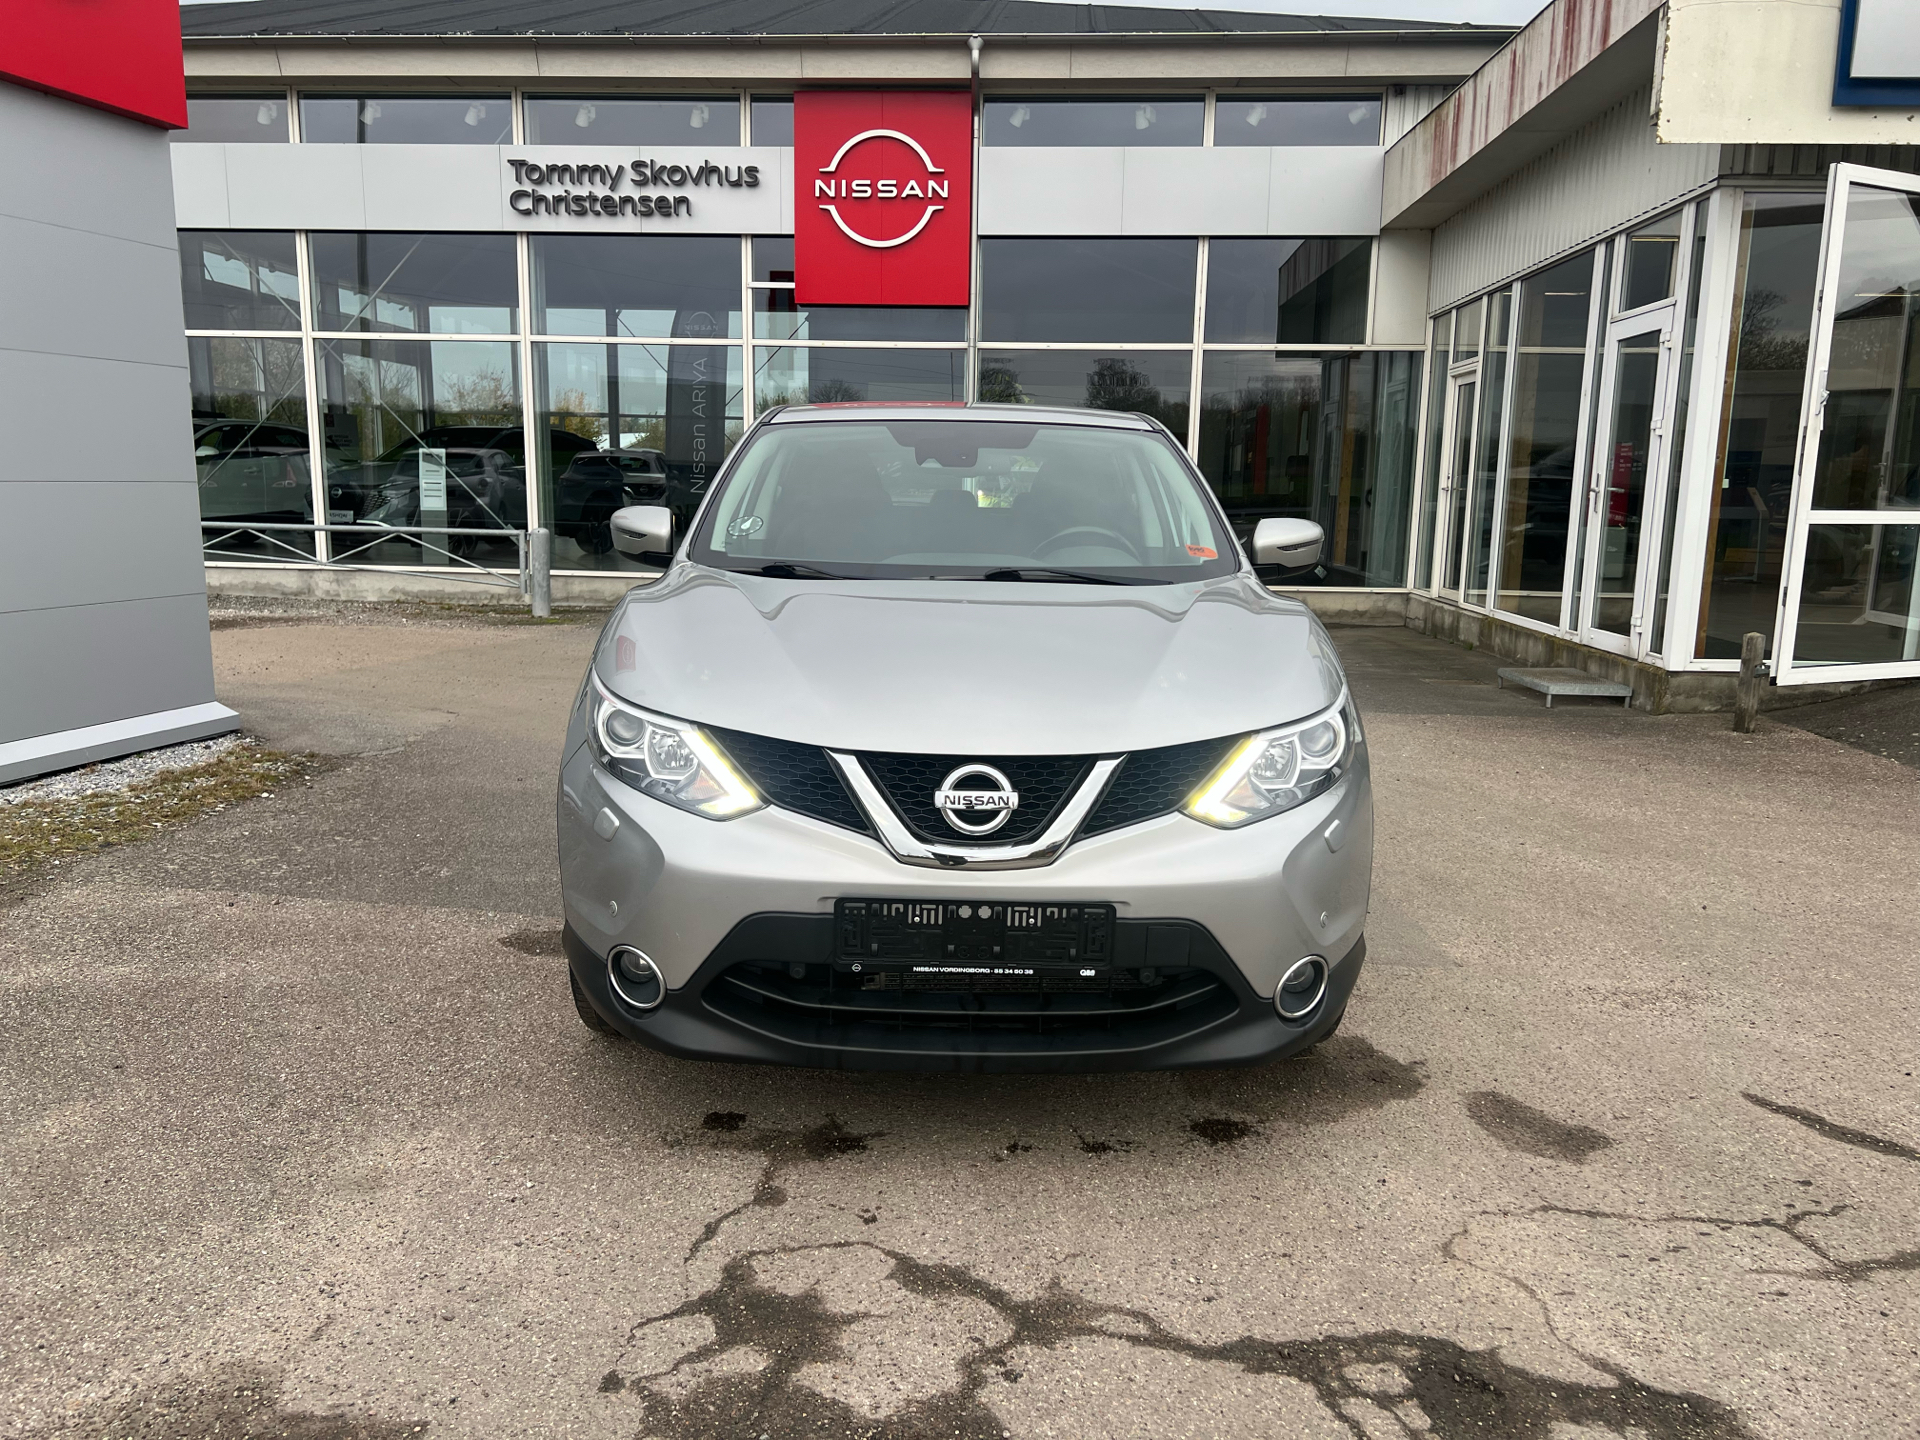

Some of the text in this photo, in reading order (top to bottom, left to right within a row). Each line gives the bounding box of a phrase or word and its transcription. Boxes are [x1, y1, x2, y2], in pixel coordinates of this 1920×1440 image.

[507, 159, 760, 191] Tommy Skovhus
[814, 179, 949, 198] NISSAN
[509, 188, 692, 217] Christensen
[690, 357, 708, 494] Nissan ARIYA
[944, 795, 1010, 806] NISSAN
